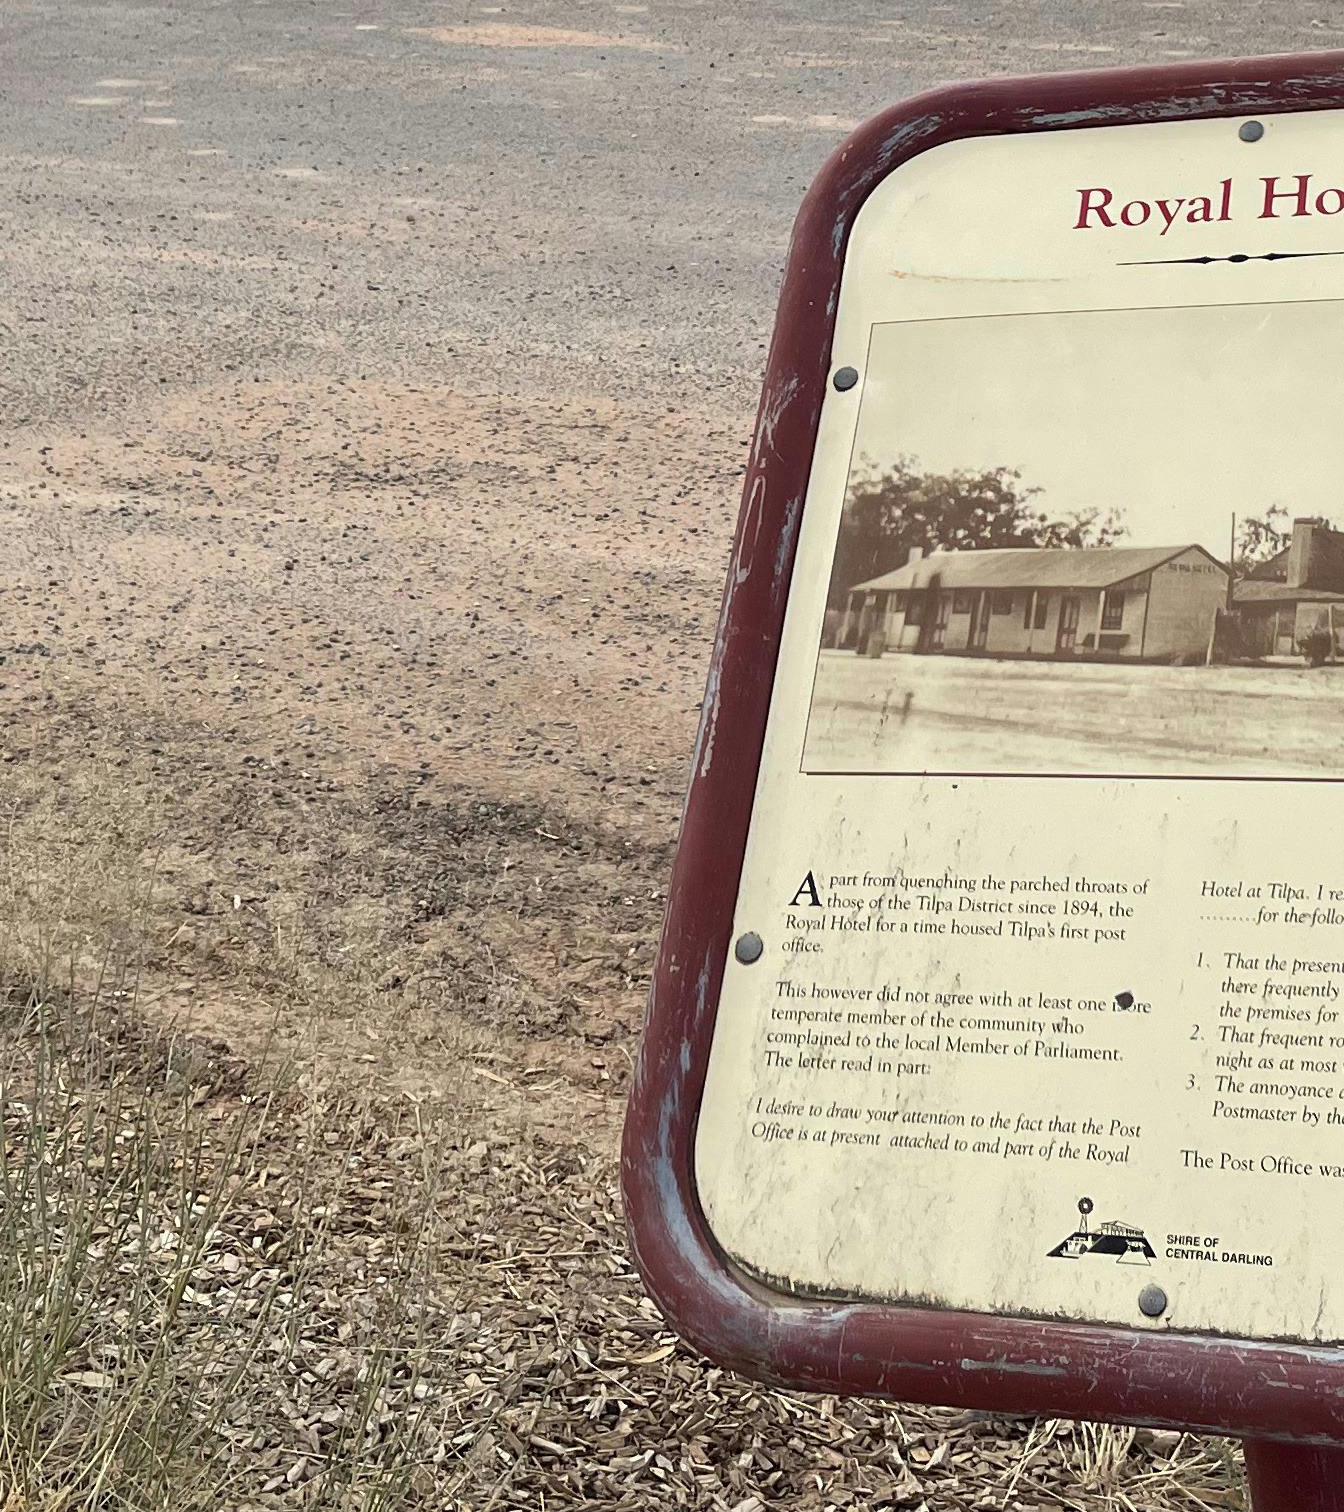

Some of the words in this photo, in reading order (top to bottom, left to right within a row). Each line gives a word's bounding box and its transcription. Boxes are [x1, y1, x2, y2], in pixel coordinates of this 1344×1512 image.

[1072, 178, 1233, 236] Royal
[829, 875, 859, 890] part
[862, 873, 895, 888] from
[896, 875, 977, 897] quenching
[981, 874, 1006, 891] the
[1009, 875, 1070, 895] parched
[1075, 876, 1128, 895] throats
[1201, 880, 1243, 898] Hotel
[1267, 882, 1310, 904] Tilpa.
[827, 892, 865, 911] those
[888, 891, 912, 911] the
[915, 892, 953, 916] Tilpa
[958, 896, 1014, 915] District
[1017, 900, 1057, 915] since
[1063, 899, 1103, 919] 1894,
[1109, 900, 1134, 918] the
[785, 914, 826, 937] Royal
[830, 913, 871, 931] Hotel
[876, 914, 897, 933] for
[913, 919, 946, 934] time
[950, 918, 1003, 936] housed
[1007, 920, 1056, 941] Tilpa's
[1060, 922, 1090, 940] first
[1094, 928, 1126, 944] post
[781, 935, 824, 957] office.
[1224, 952, 1259, 970] That
[1265, 953, 1287, 972] the
[775, 979, 807, 998] This
[808, 982, 873, 1004] however
[876, 983, 901, 1002] did
[904, 991, 931, 1005] not
[930, 993, 974, 1009] agree
[979, 990, 1013, 1008] with
[1038, 992, 1073, 1011] least
[1077, 1000, 1107, 1012] one
[1221, 975, 1258, 993] there
[1261, 977, 1340, 1002] frequently
[771, 1006, 843, 1028] temperate
[847, 1006, 907, 1026] member
[930, 1009, 955, 1026] the
[959, 1016, 1046, 1037] community
[1051, 1015, 1084, 1035] who
[1219, 1000, 1242, 1018] the
[1246, 1004, 1312, 1024] premises
[1314, 1004, 1340, 1026] for
[767, 1027, 852, 1050] complained
[876, 1031, 900, 1050] the
[904, 1033, 940, 1053] local
[945, 1035, 1010, 1055] Member
[1034, 1040, 1123, 1062] Parliament.
[1218, 1024, 1256, 1045] That
[1257, 1026, 1324, 1050] frequent
[764, 1050, 793, 1068] The
[798, 1050, 837, 1070] letter
[841, 1053, 874, 1072] read
[896, 1062, 931, 1078] part:
[1216, 1049, 1253, 1072] night
[1300, 1060, 1338, 1074] most
[1214, 1074, 1245, 1094] The
[1249, 1082, 1334, 1101] annoyance
[765, 1097, 805, 1118] desire
[826, 1101, 862, 1120] draw
[864, 1108, 898, 1125] your
[900, 1108, 965, 1127] attention
[989, 1111, 1011, 1130] the
[1013, 1112, 1043, 1134] fact
[1048, 1114, 1077, 1136] that
[1082, 1117, 1104, 1136] the
[1108, 1119, 1141, 1138] Post
[1212, 1100, 1298, 1122] Postmaster
[1302, 1104, 1321, 1128] by
[751, 1120, 794, 1143] Office
[830, 1129, 881, 1147] present
[889, 1130, 950, 1150] attached
[972, 1136, 1001, 1154] and
[1003, 1140, 1034, 1159] part
[1058, 1140, 1081, 1160] the
[1086, 1143, 1130, 1166] Royal
[1180, 1149, 1215, 1169] The
[1219, 1152, 1255, 1172] Post
[1260, 1155, 1313, 1176] Office
[1166, 1234, 1200, 1246] SHIRE
[1203, 1237, 1219, 1247] OF
[1165, 1248, 1218, 1262] CENTRAL
[1221, 1254, 1273, 1267] DARLING
